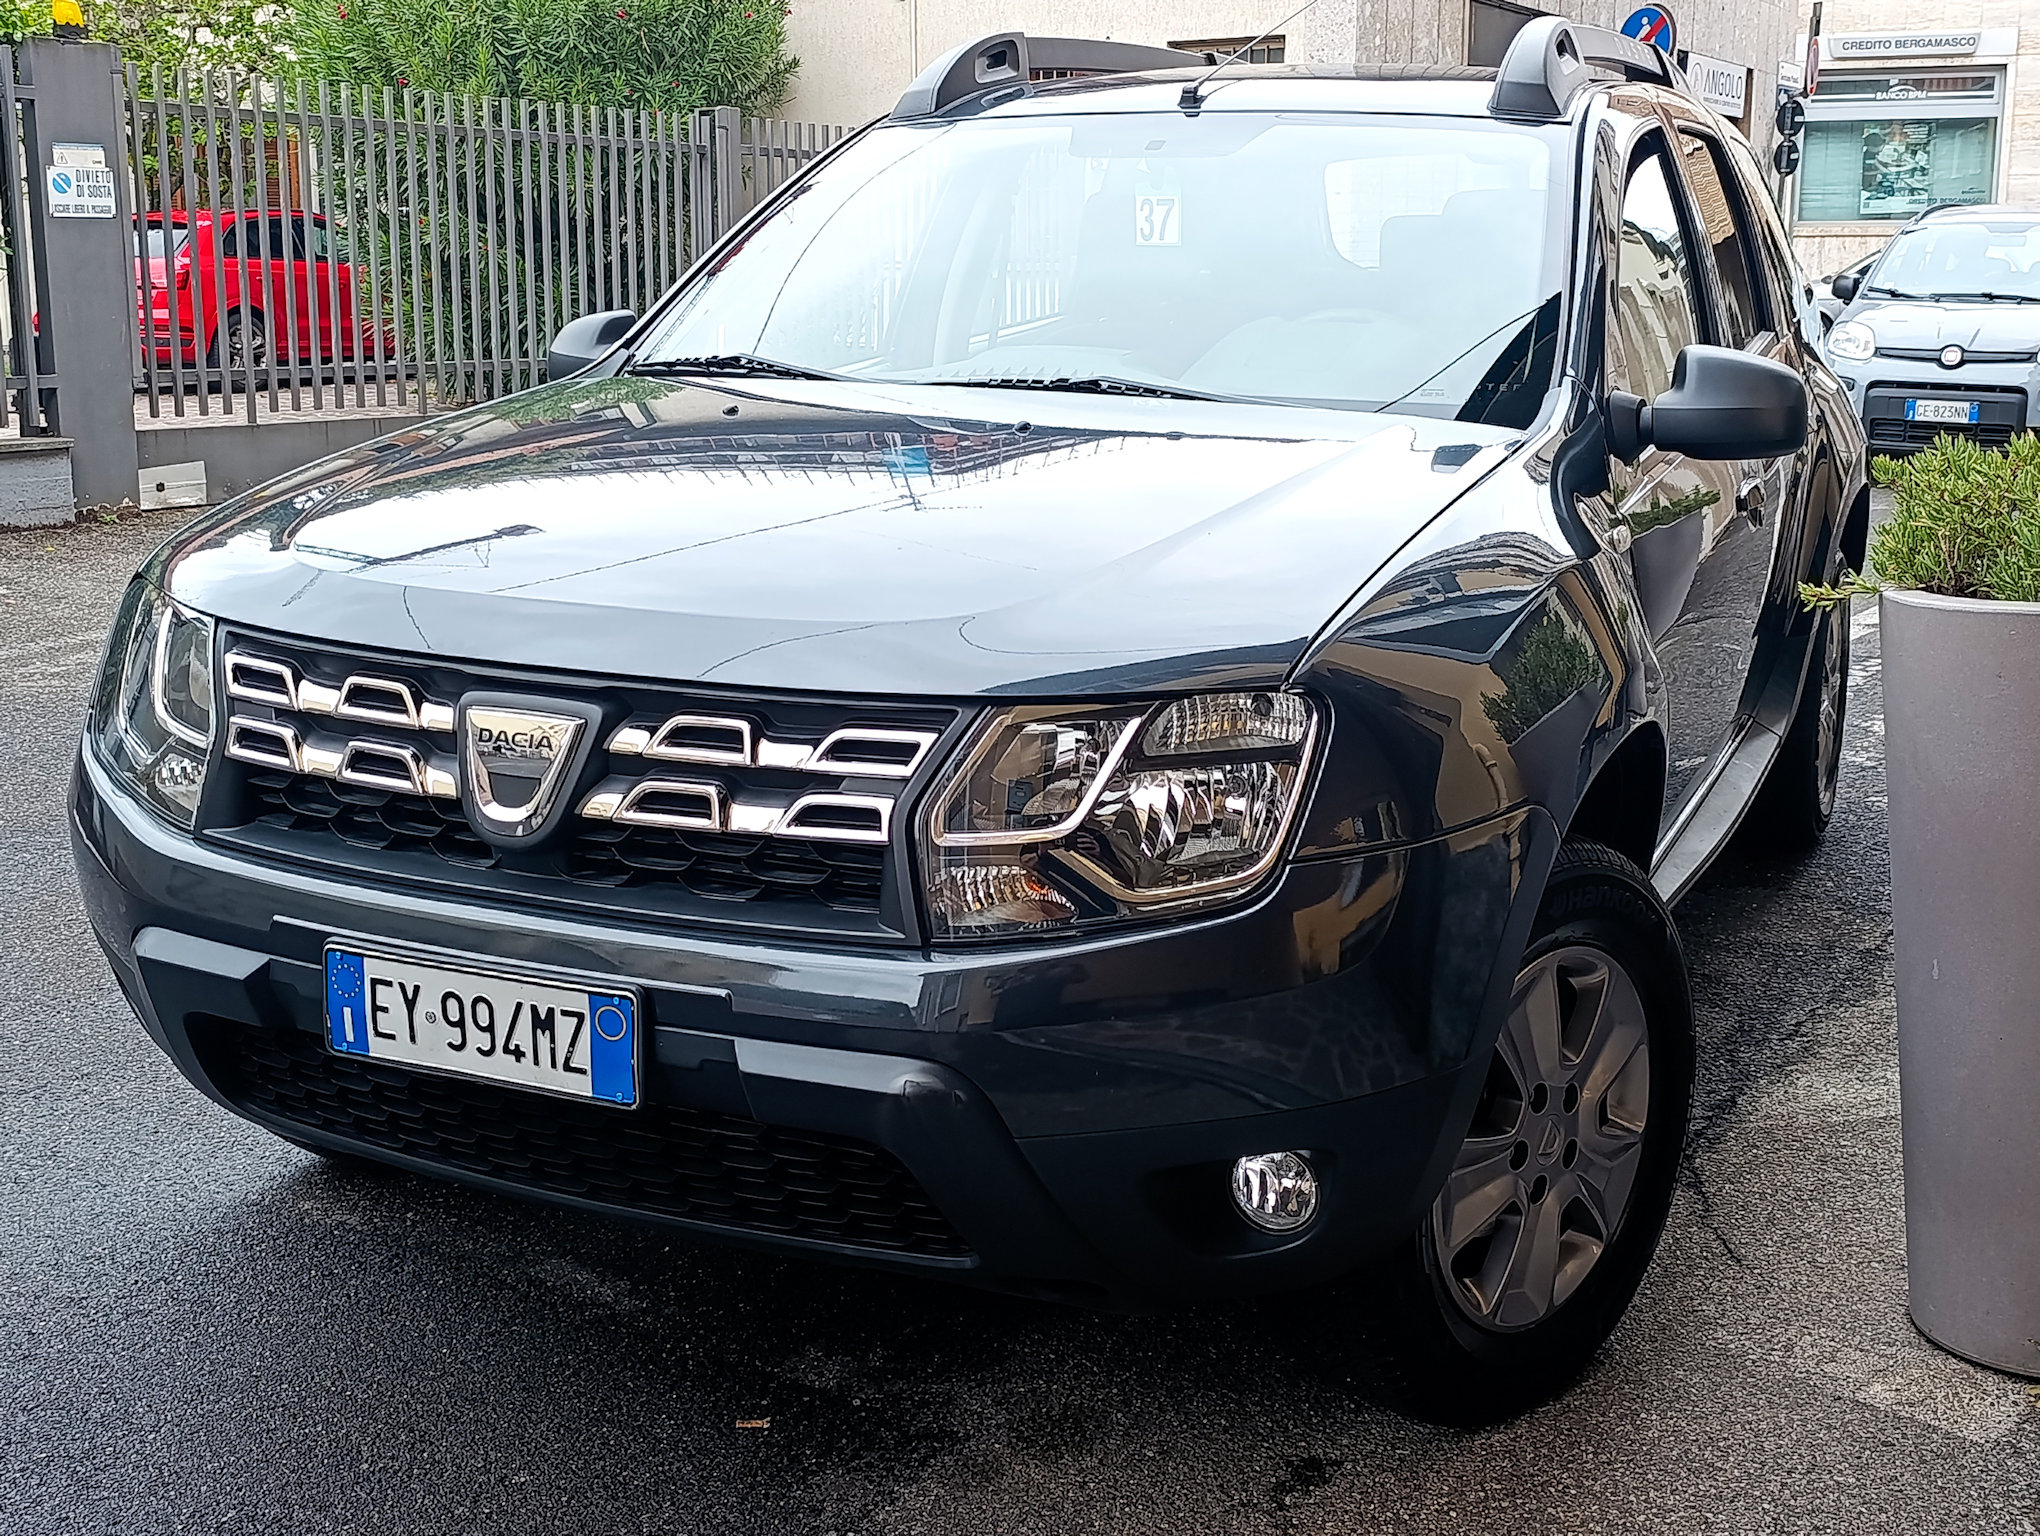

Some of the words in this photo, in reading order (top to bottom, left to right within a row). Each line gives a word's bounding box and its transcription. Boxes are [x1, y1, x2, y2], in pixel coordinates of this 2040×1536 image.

[1842, 39, 1892, 51] CREDITO
[1895, 36, 1976, 49] BERGAMASCO
[1703, 68, 1743, 100] ANGOLO
[76, 169, 111, 183] DIVIETO
[76, 185, 84, 197] DI
[87, 185, 112, 198] SOSTA
[1140, 198, 1175, 242] 37
[477, 728, 554, 752] DACIA
[369, 977, 421, 1045] EY
[440, 990, 589, 1076] 994MZ
